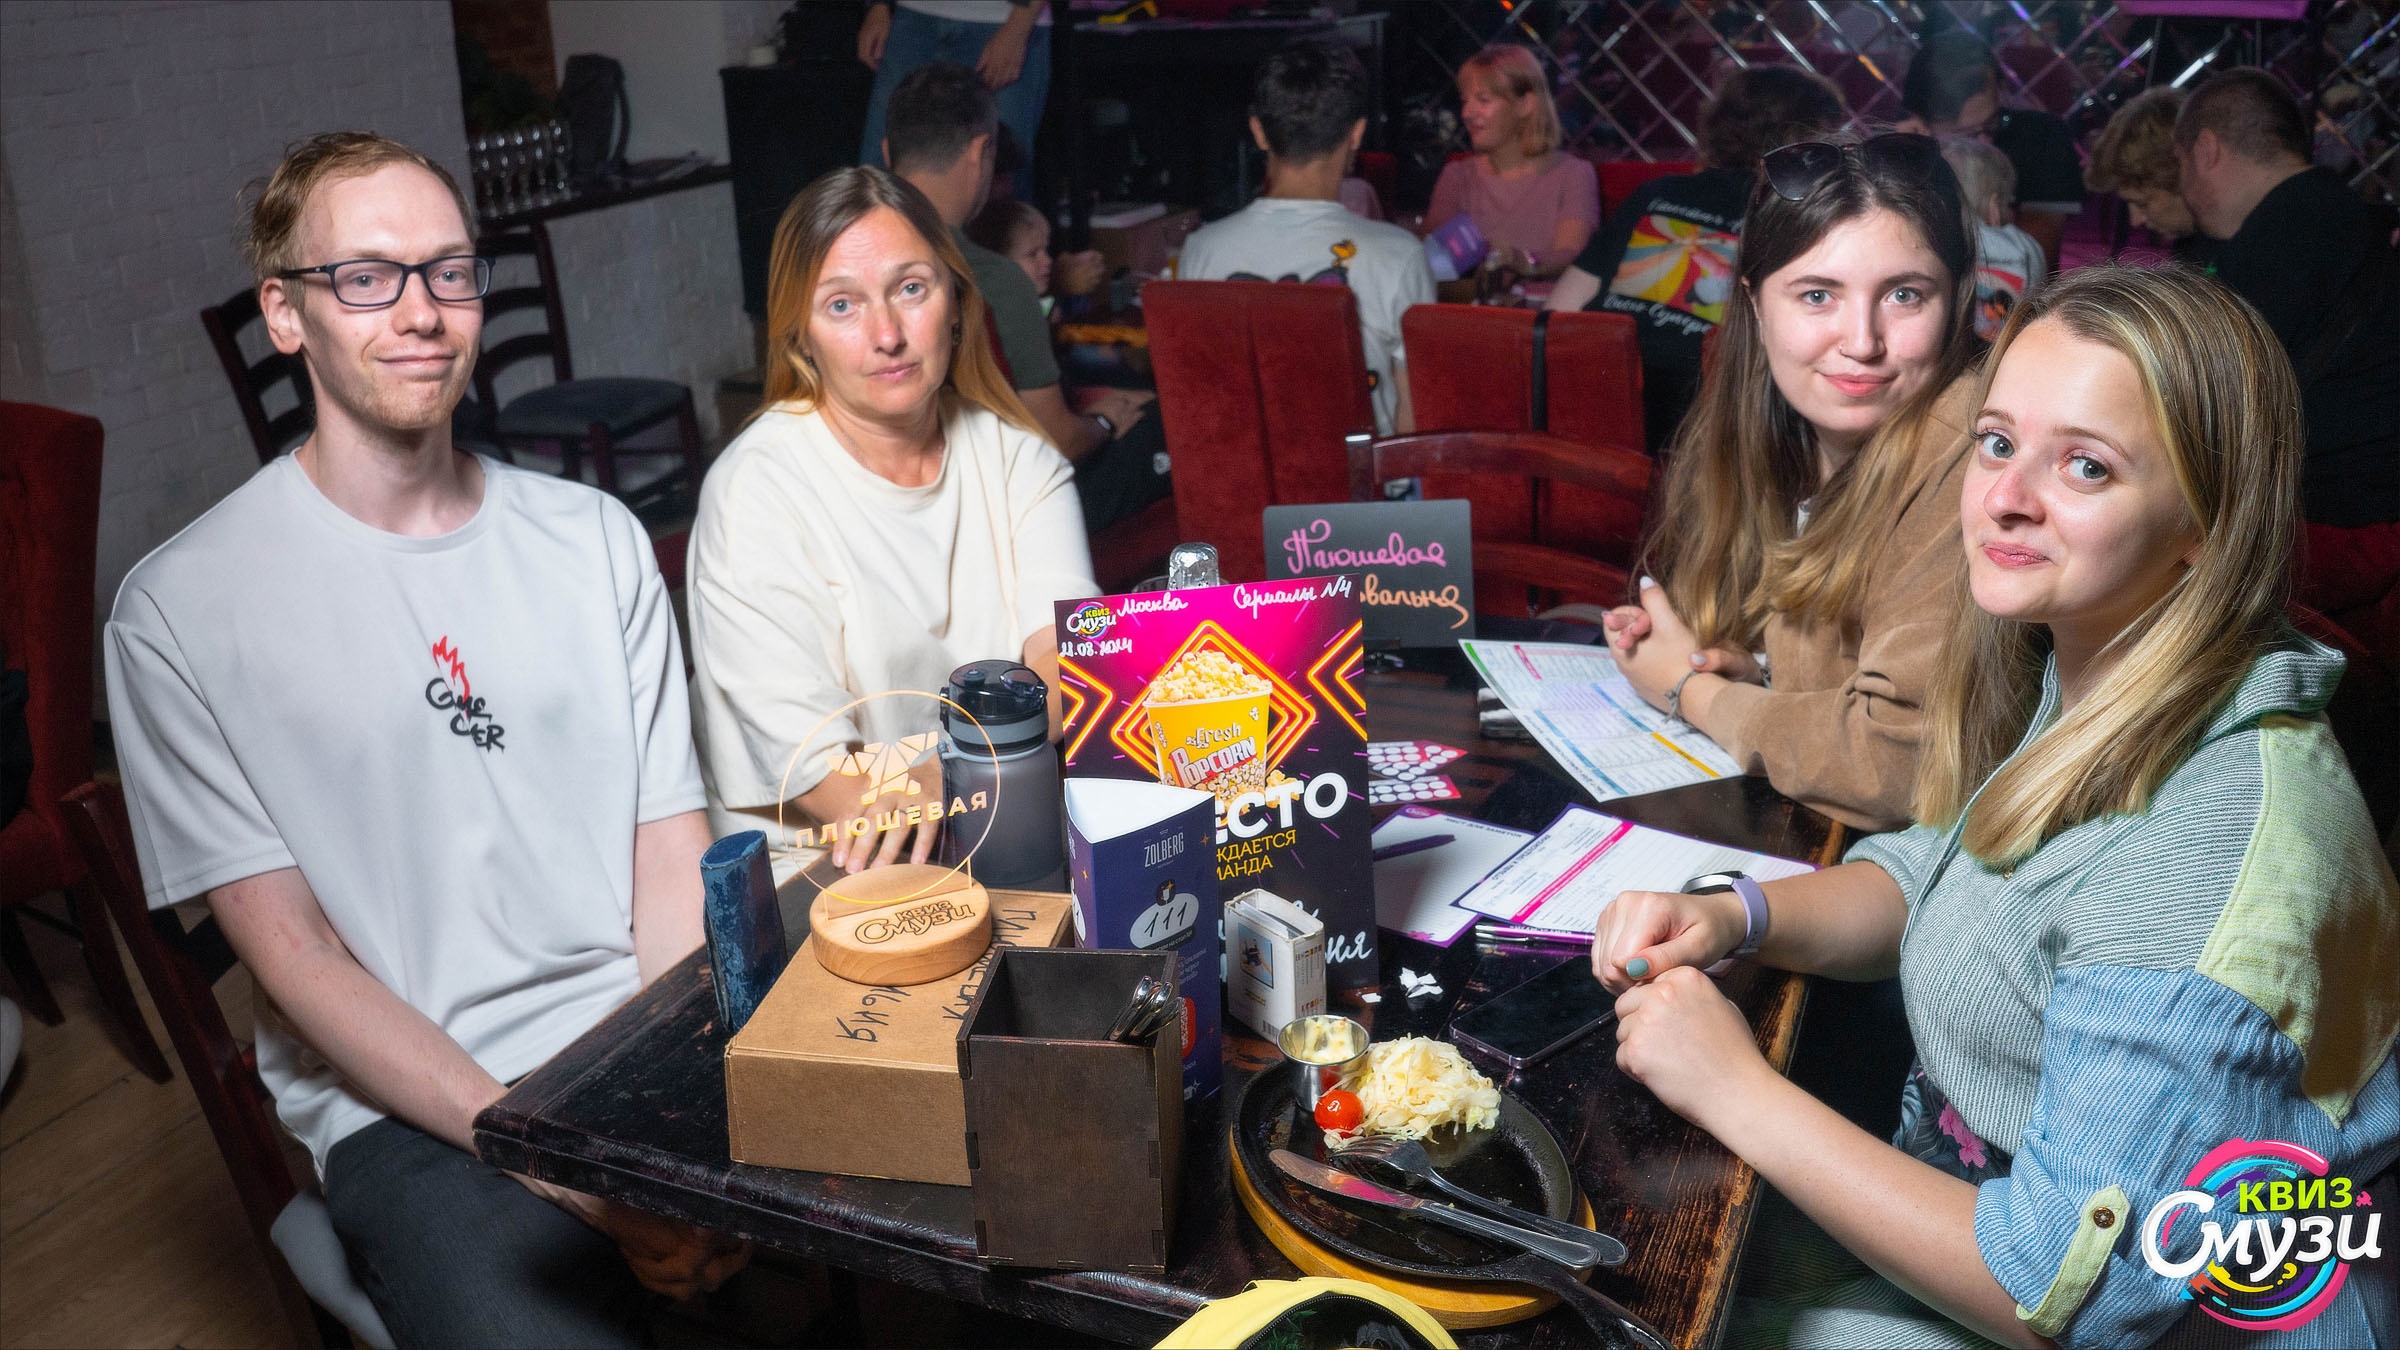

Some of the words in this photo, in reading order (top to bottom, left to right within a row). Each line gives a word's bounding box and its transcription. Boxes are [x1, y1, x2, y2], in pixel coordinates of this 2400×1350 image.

[1283, 519, 1447, 574] Плюшевая
[1085, 607, 1111, 618] КВИЗ
[1116, 592, 1189, 617] Москва
[1232, 583, 1317, 619] Сериалы
[1066, 613, 1117, 633] Смузи
[796, 790, 988, 849] ПЛЮШЕВАЯ
[1144, 832, 1185, 868] ZOLBERG
[1216, 829, 1297, 863] ЖДАЕТСЯ
[855, 903, 976, 944] Смузи
[895, 900, 954, 922] КВИЗ
[1144, 901, 1188, 938] 111
